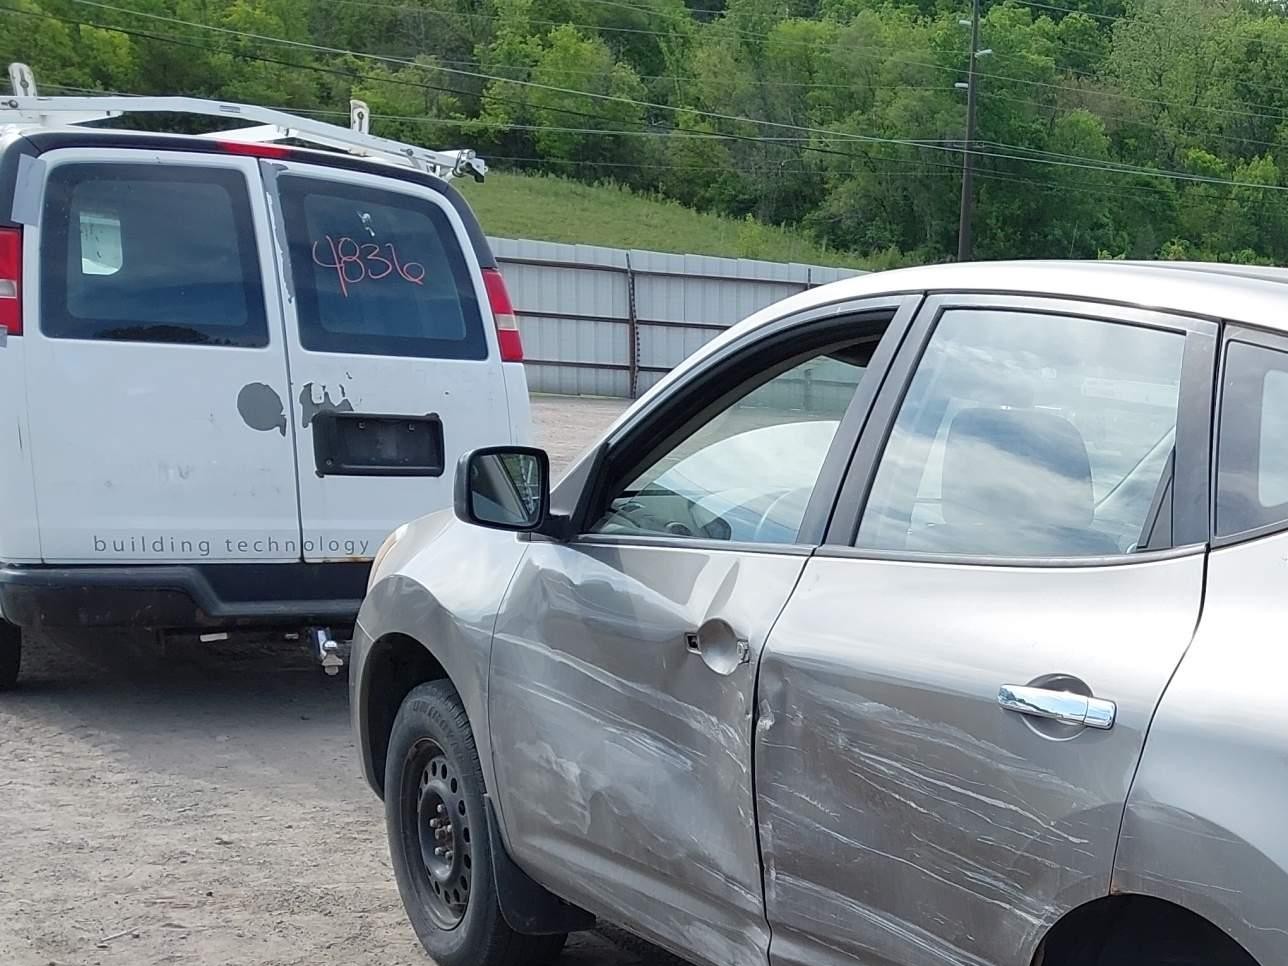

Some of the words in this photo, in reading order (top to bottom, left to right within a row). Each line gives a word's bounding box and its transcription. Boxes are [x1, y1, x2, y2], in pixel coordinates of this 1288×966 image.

[312, 235, 425, 297] 4836
[93, 535, 211, 556] building
[225, 536, 370, 556] technology
